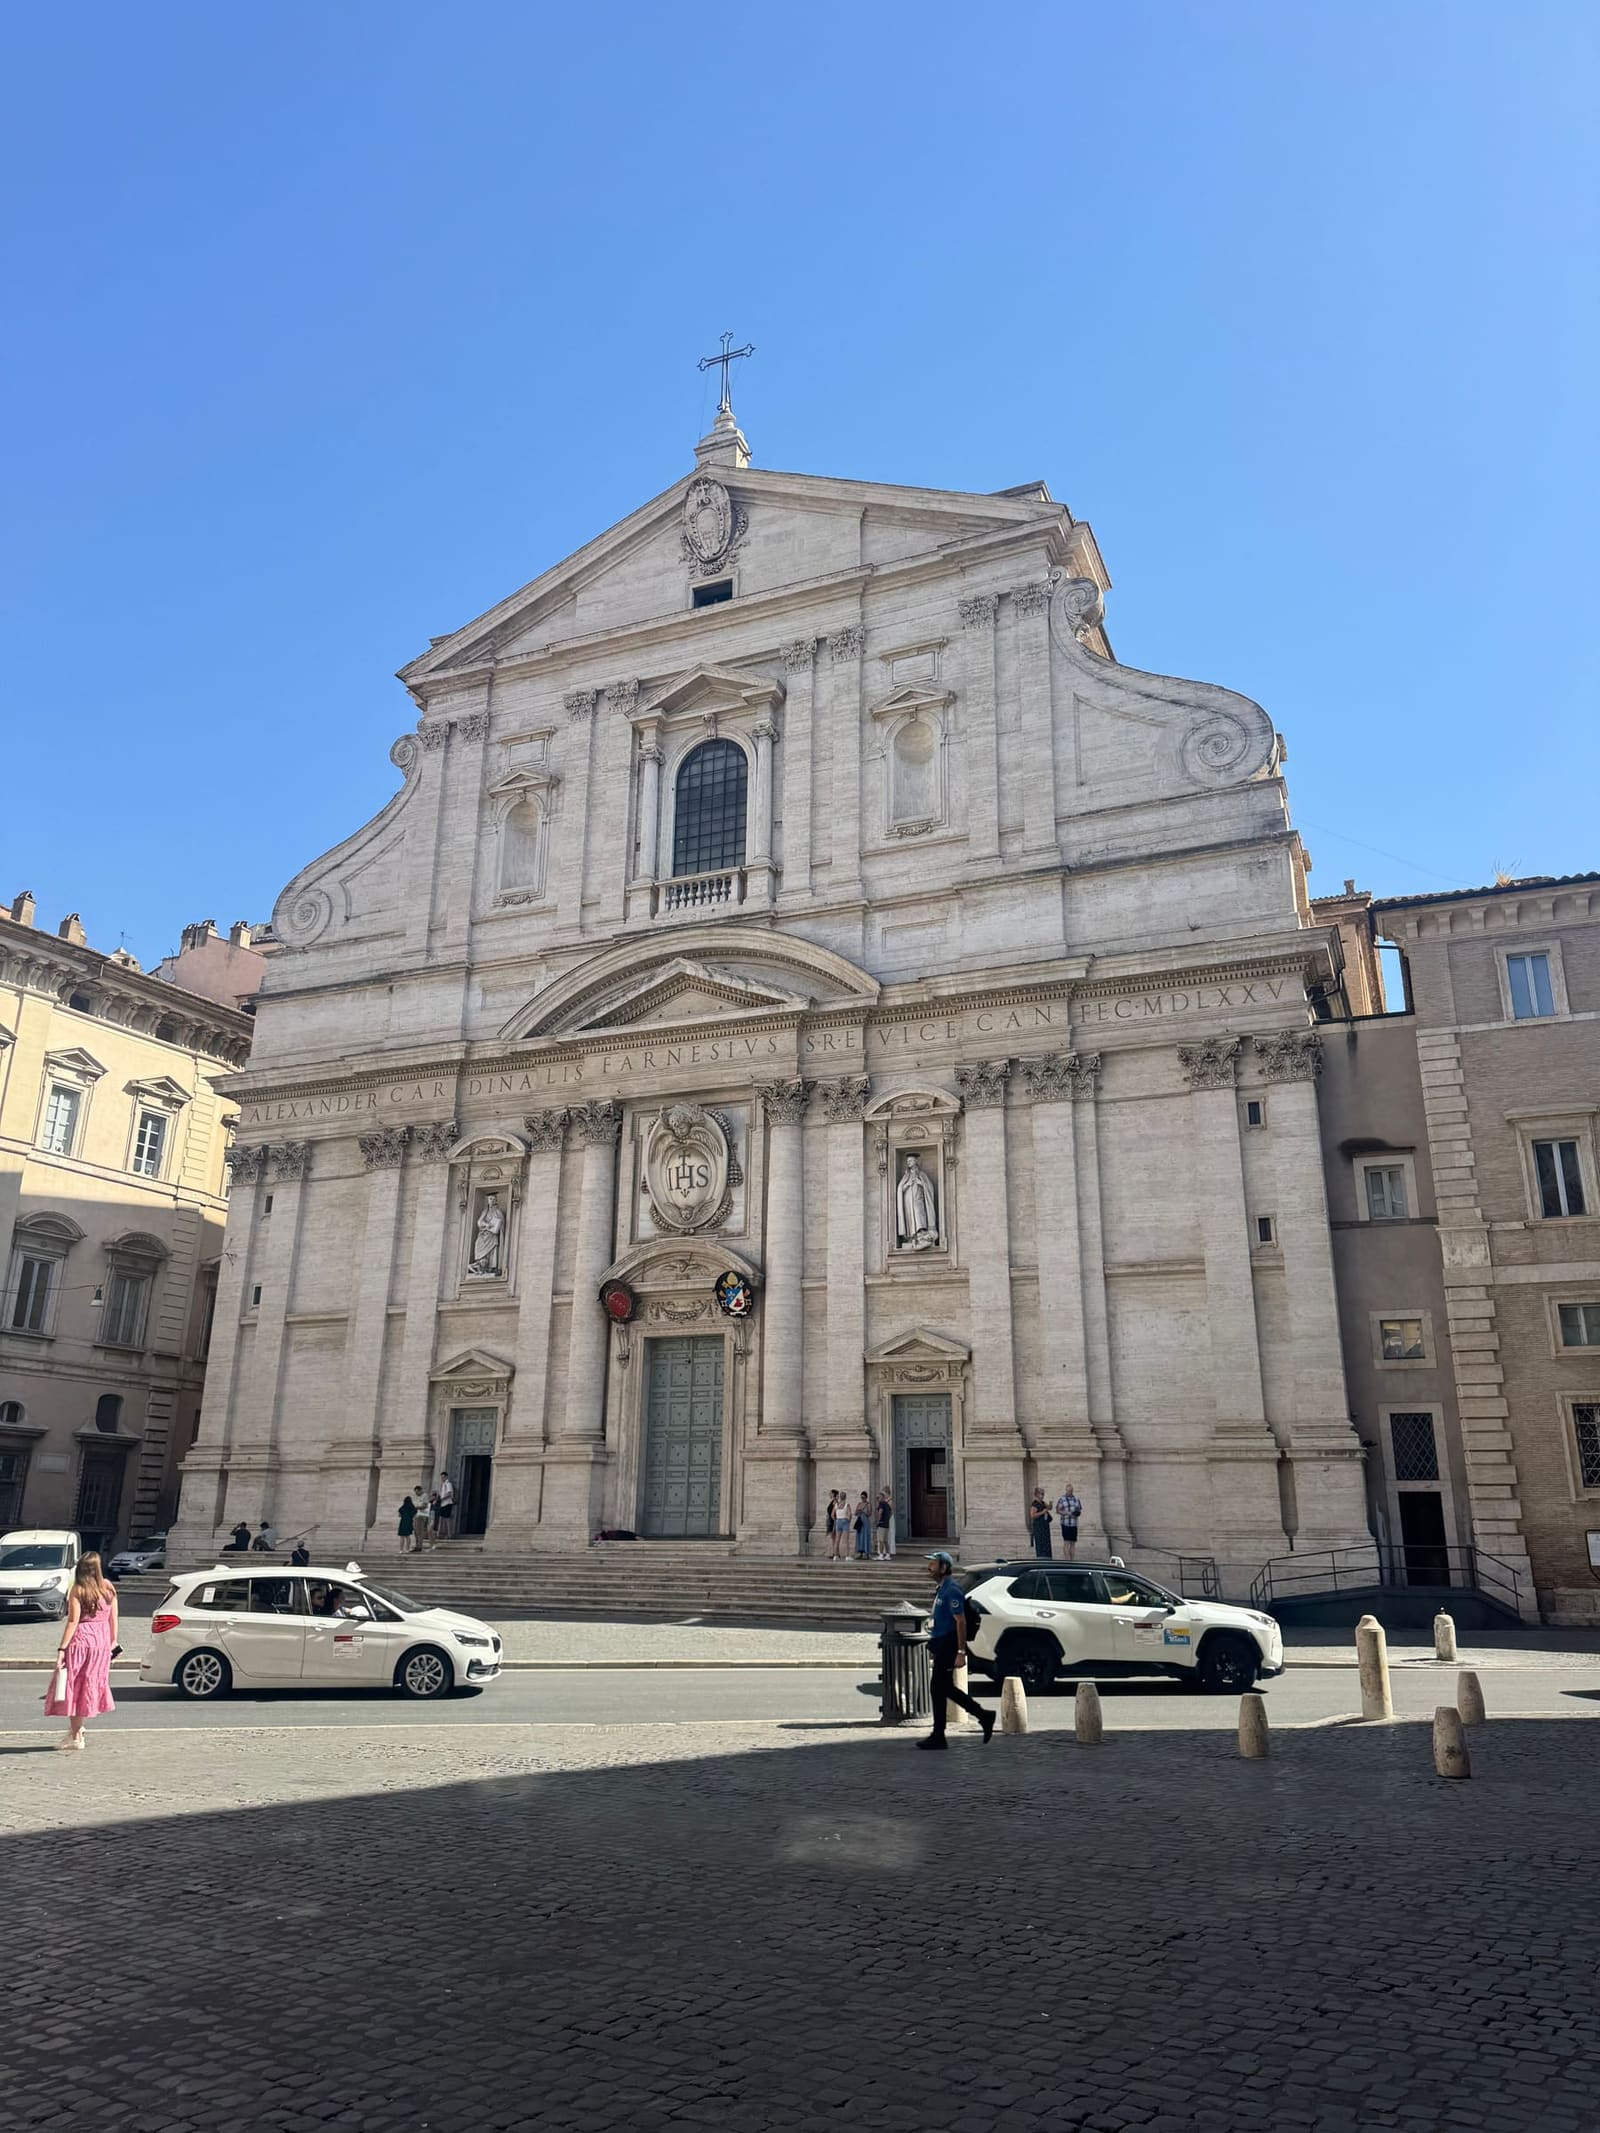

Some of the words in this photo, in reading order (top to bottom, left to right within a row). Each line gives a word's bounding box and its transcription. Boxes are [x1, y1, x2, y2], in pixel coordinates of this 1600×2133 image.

[250, 1092, 378, 1123] ALEXANDER
[390, 1064, 585, 1103] CARDINALIS
[603, 1036, 777, 1074] FARNESIVS
[668, 1164, 709, 1191] IHS
